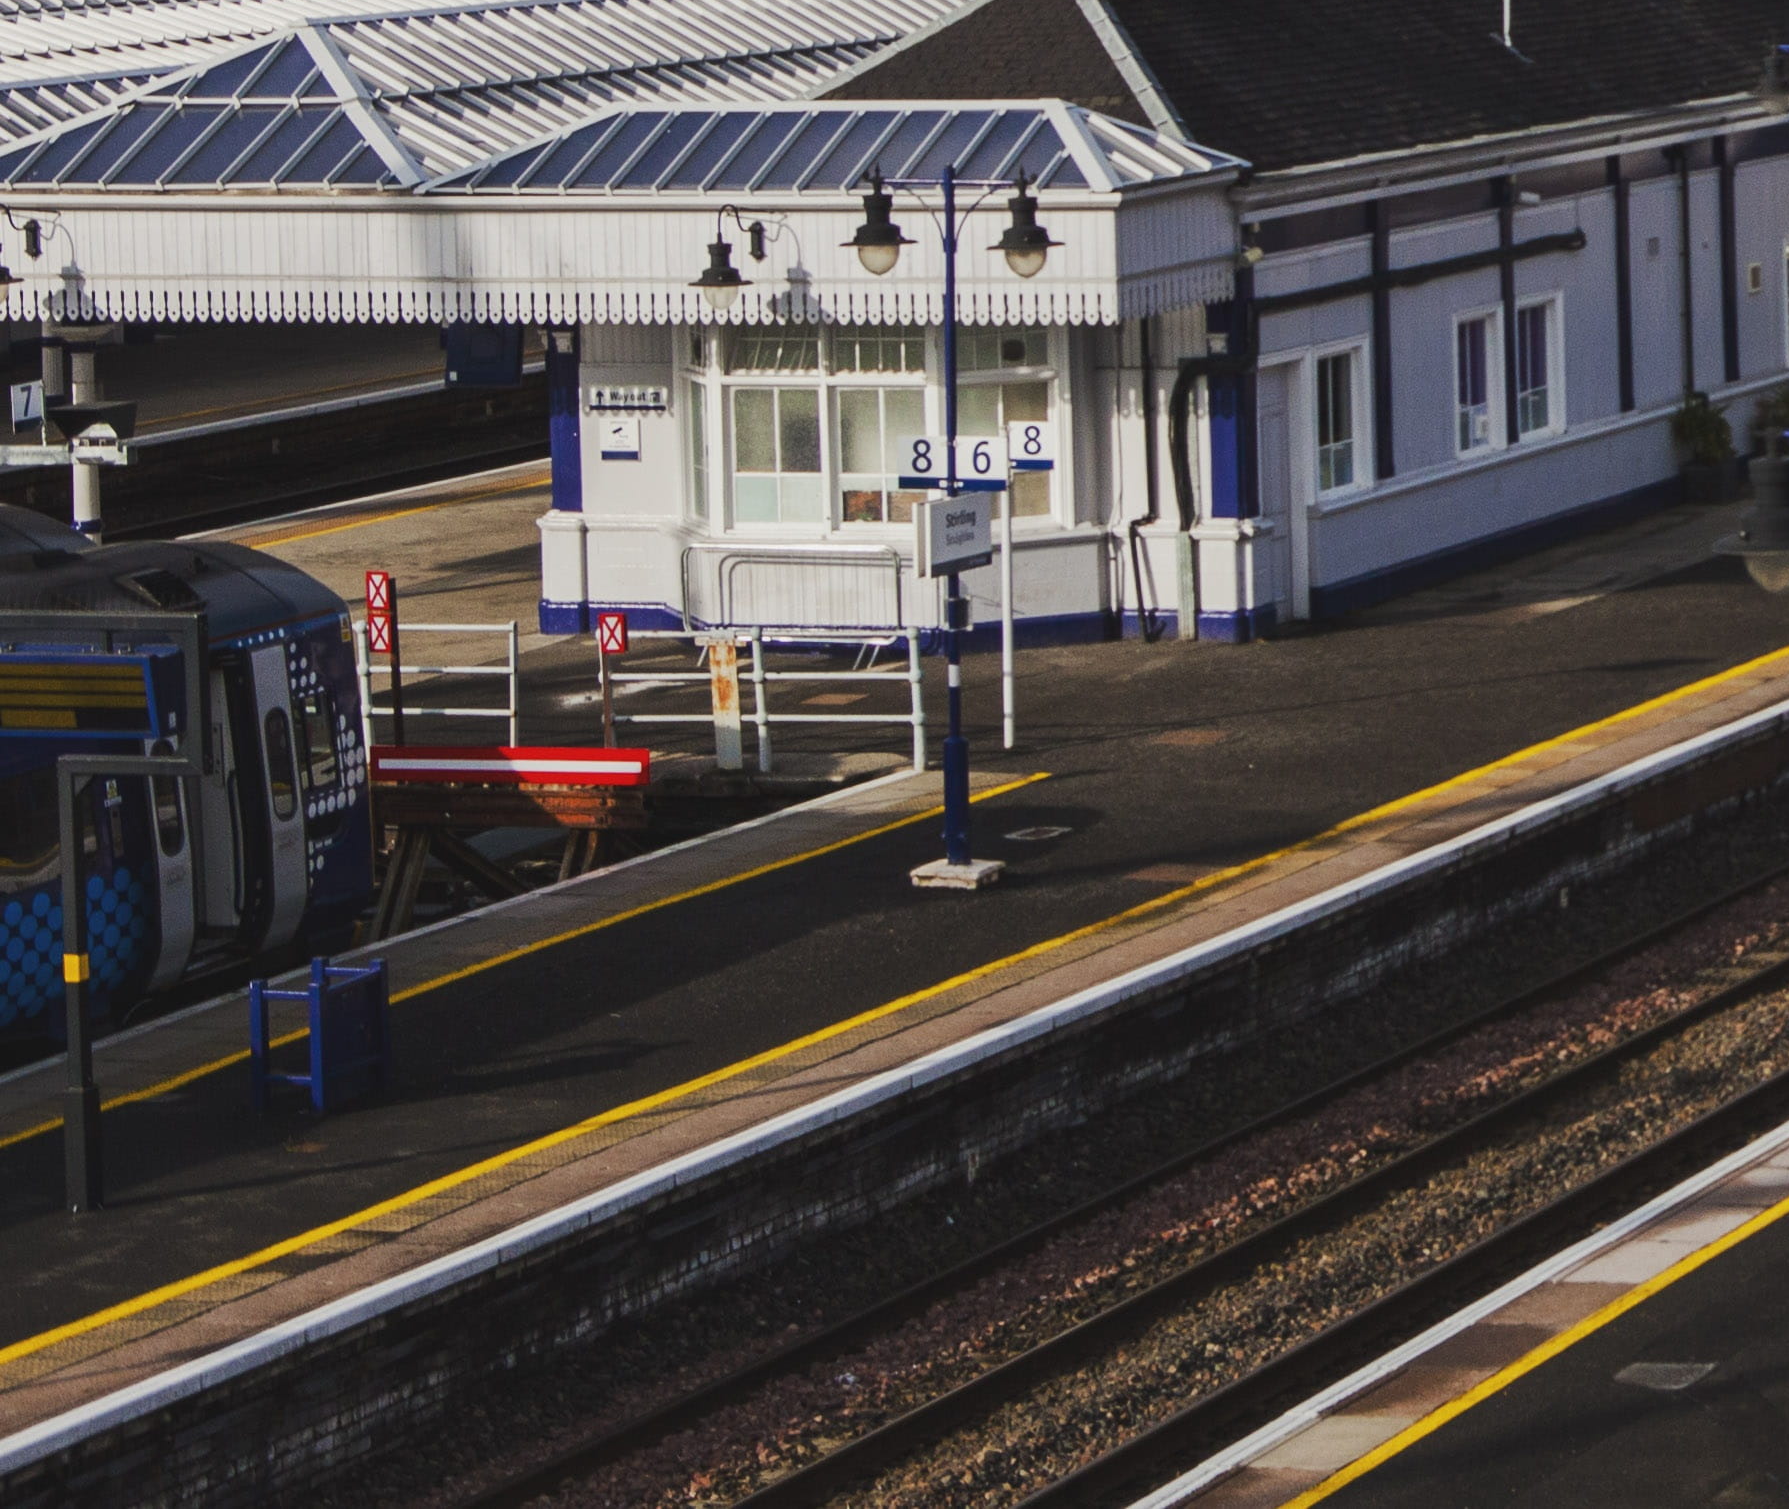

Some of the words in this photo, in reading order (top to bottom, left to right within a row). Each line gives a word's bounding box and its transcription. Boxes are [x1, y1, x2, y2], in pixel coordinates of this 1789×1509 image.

[20, 384, 32, 418] 7
[911, 439, 933, 474] 8
[1023, 425, 1042, 456] 8
[972, 441, 992, 475] 6
